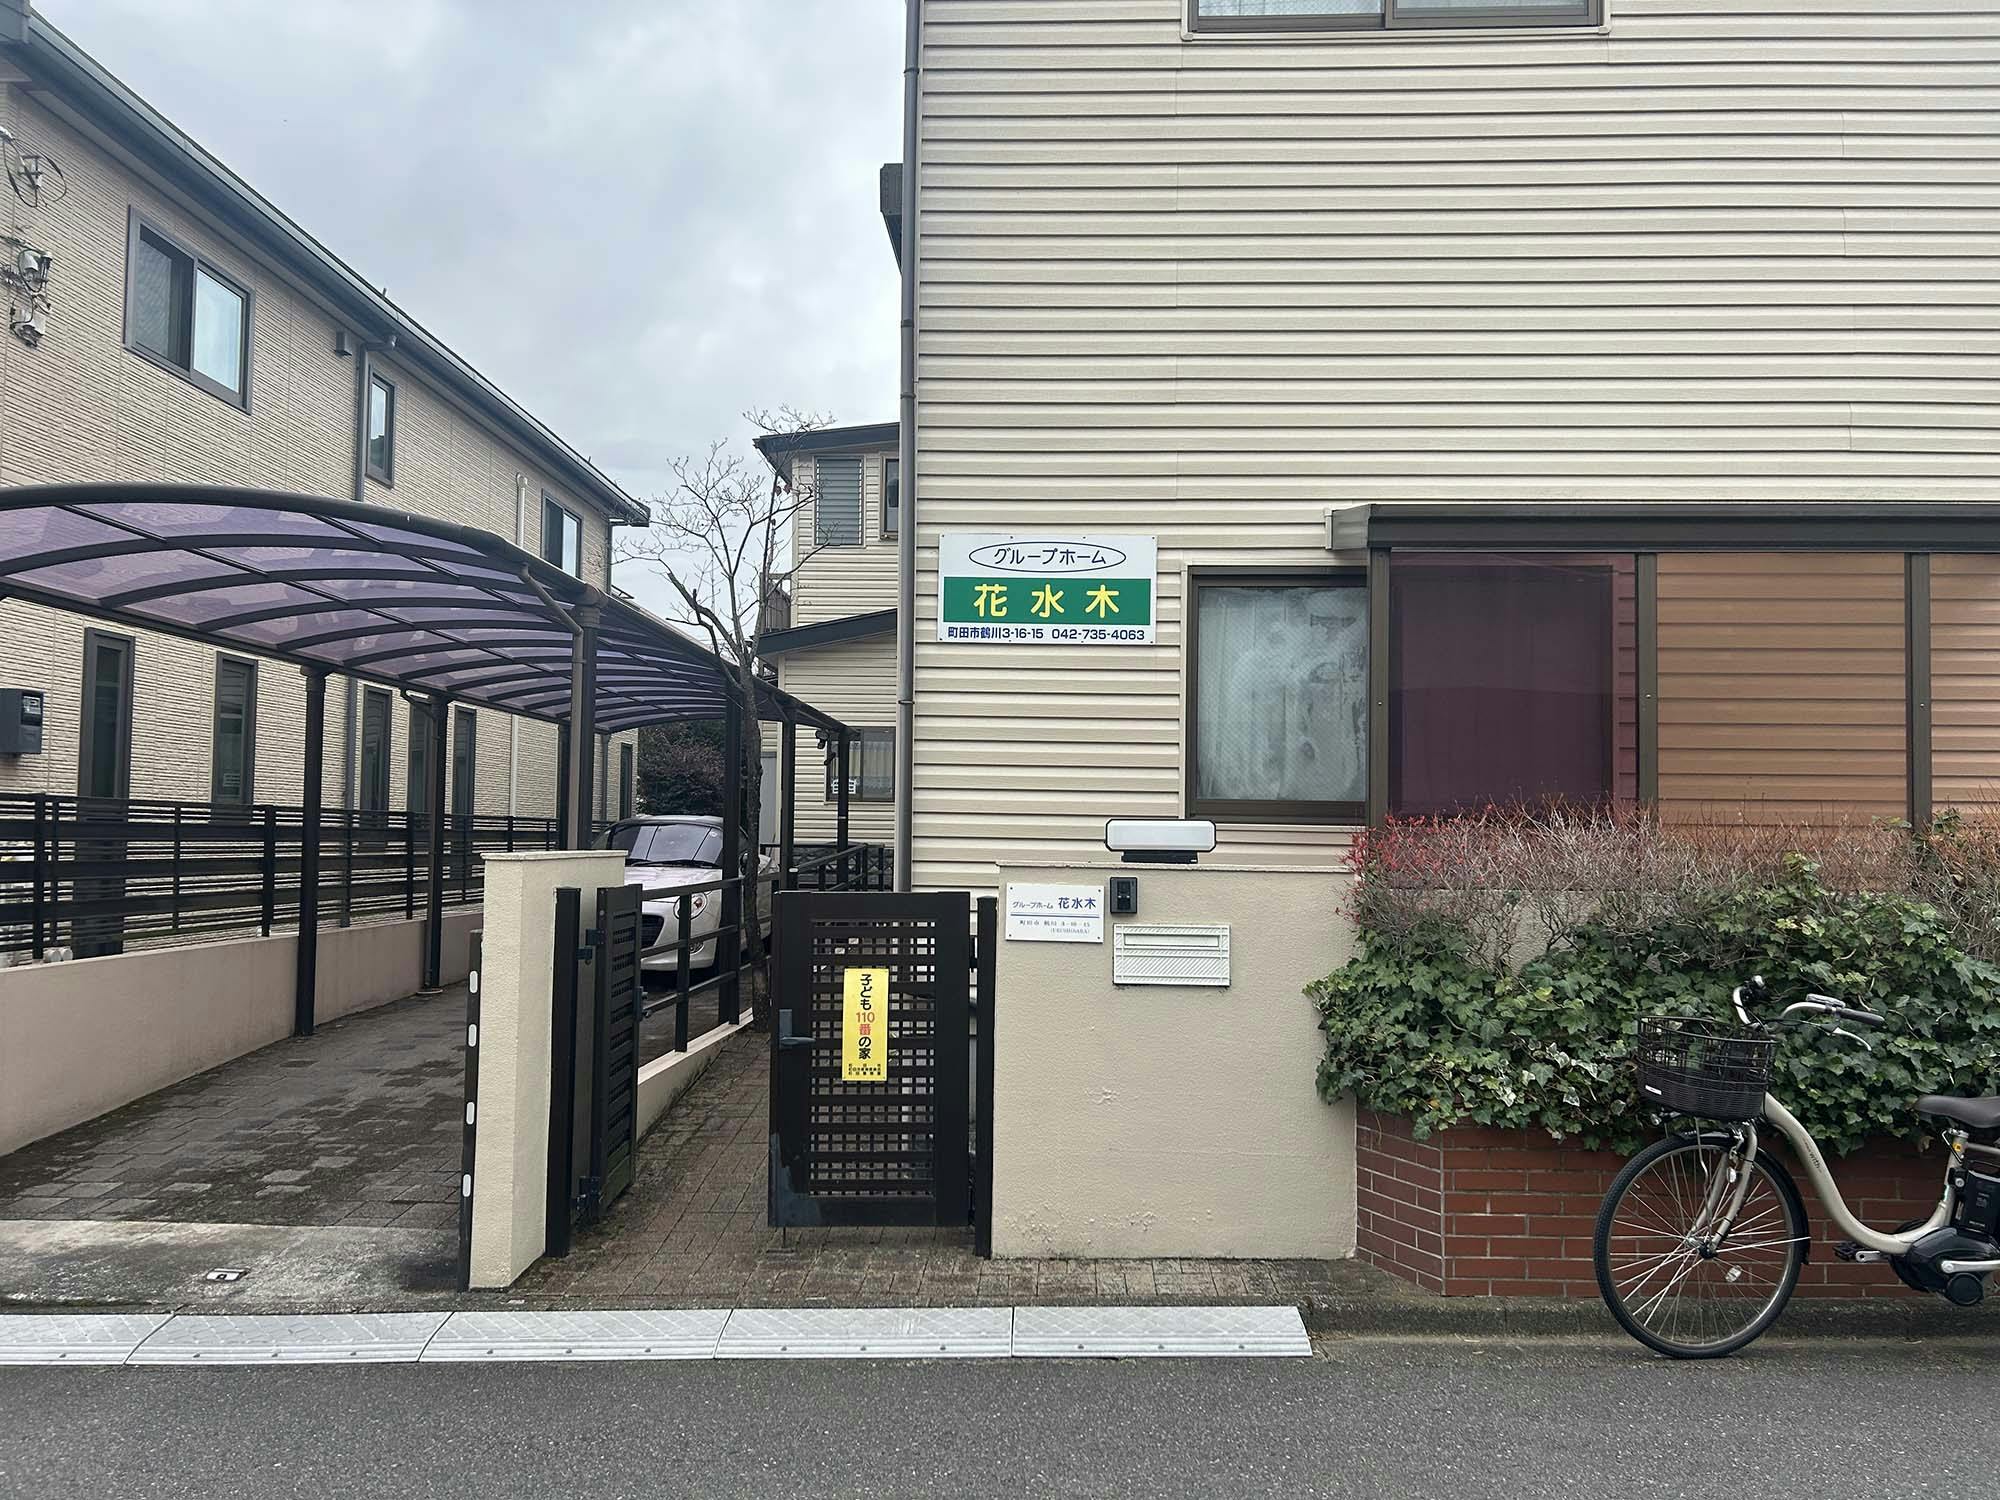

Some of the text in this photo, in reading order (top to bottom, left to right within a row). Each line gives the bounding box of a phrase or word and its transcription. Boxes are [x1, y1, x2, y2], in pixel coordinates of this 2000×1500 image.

[994, 547, 1107, 565] グループホーム
[947, 626, 1145, 640] 町田市鶴川3-16-15 042-735-4063
[1012, 897, 1097, 910] グループホーム 花水木
